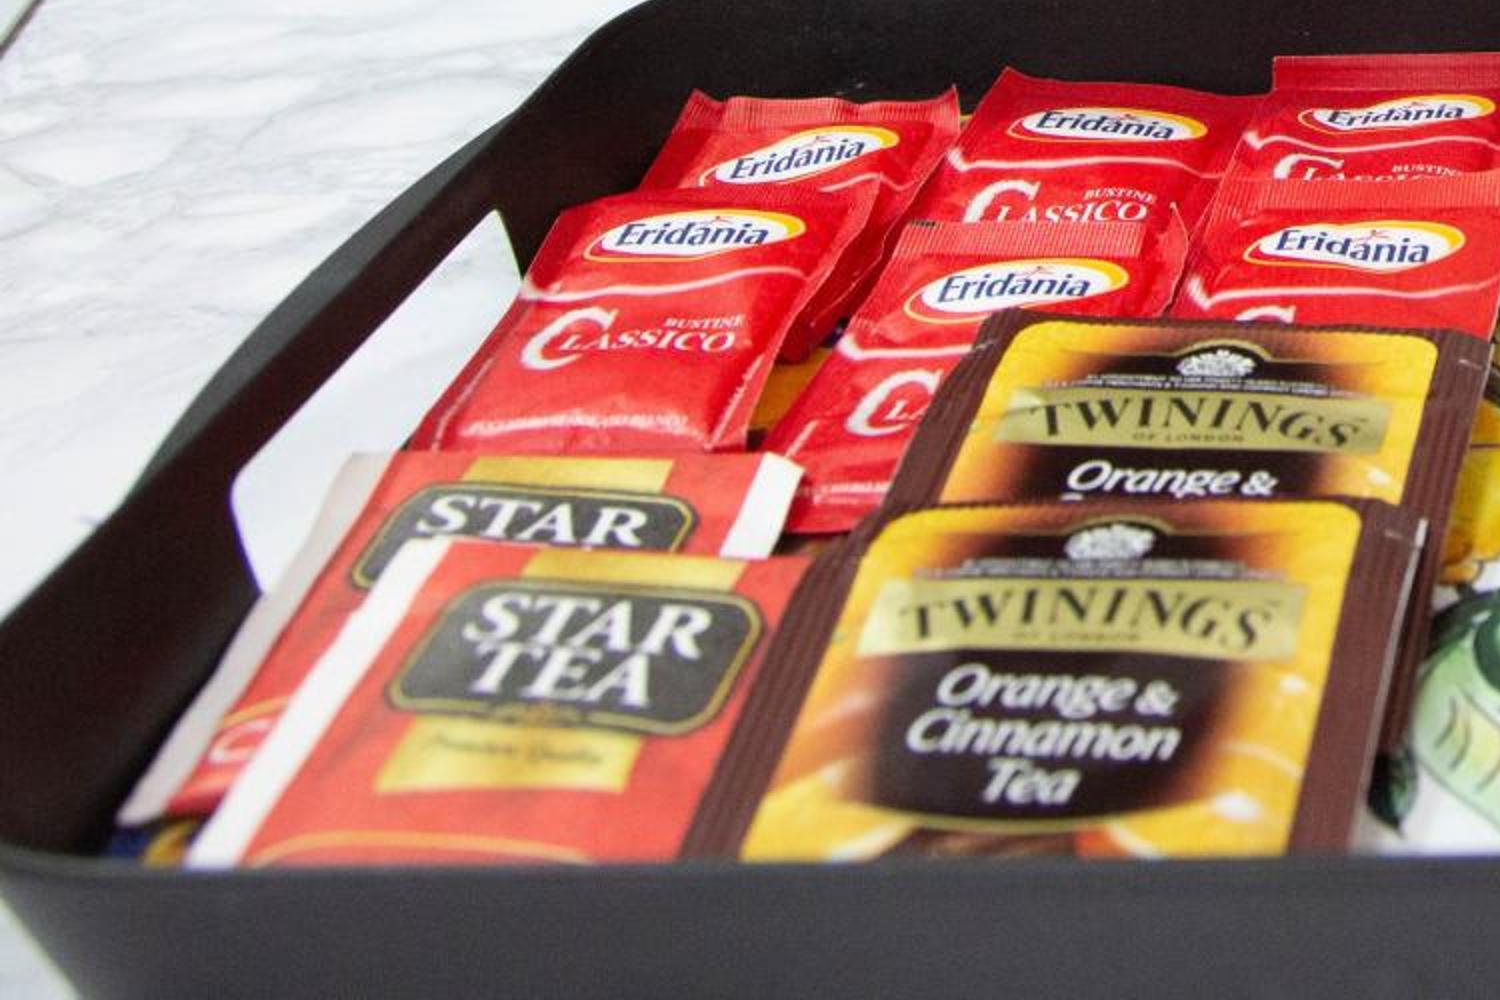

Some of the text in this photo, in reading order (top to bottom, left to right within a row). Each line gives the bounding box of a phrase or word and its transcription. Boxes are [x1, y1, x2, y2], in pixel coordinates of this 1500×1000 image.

[1036, 111, 1175, 140] Eridania
[1326, 103, 1465, 126] Eridania
[730, 138, 866, 180] Eridania
[1084, 186, 1157, 203] BUSTINE
[615, 220, 770, 246] Eridania
[1276, 229, 1430, 264] Eridania
[938, 272, 1091, 303] Eridania
[521, 306, 736, 371] CLASSICO
[663, 315, 745, 329] BUSTINE
[1029, 394, 1361, 448] TWININGS
[1066, 460, 1279, 499] Orange &
[415, 494, 648, 548] STAR
[461, 592, 713, 660] STAR
[900, 584, 1272, 651] TWININGS
[469, 641, 651, 708] TEA
[936, 663, 1179, 719] Orange &
[906, 710, 1181, 761] Cinnamon
[983, 759, 1082, 805] Tea
